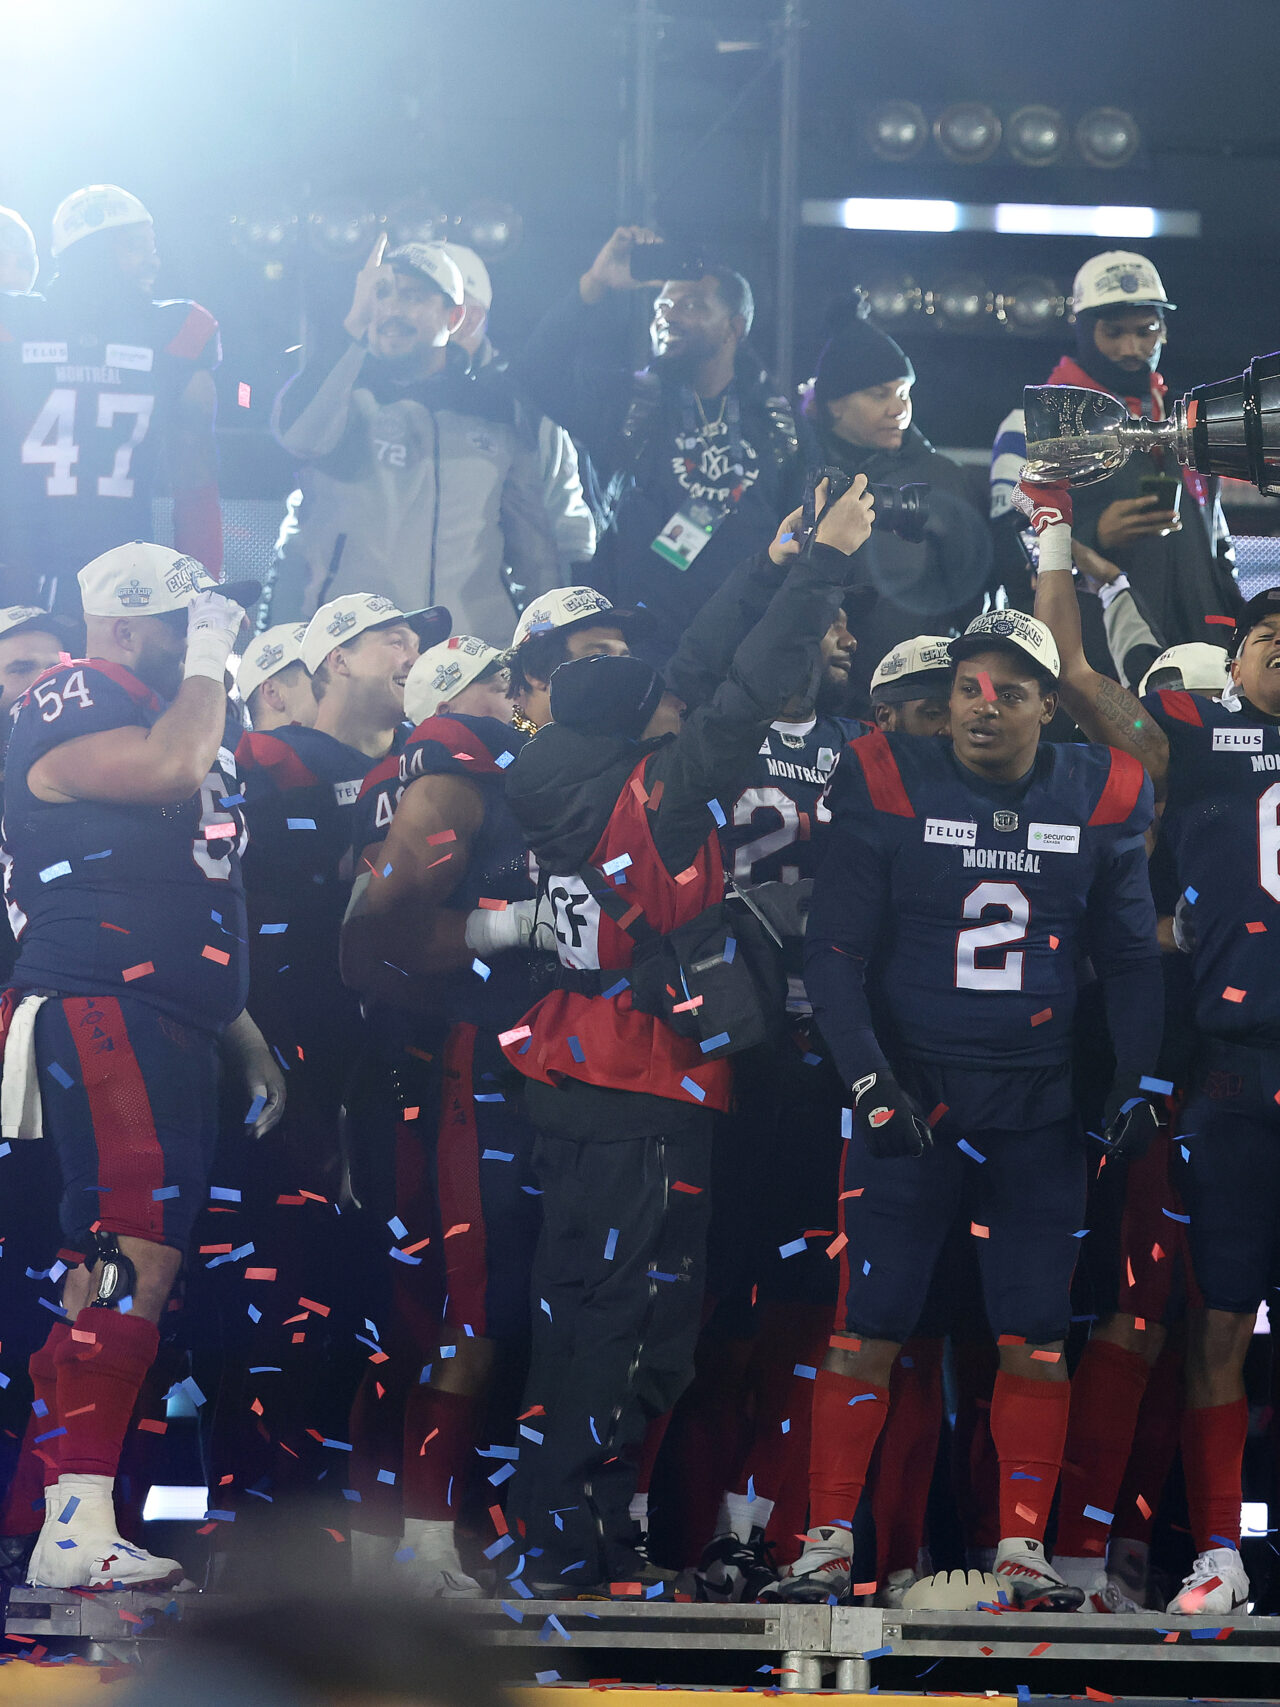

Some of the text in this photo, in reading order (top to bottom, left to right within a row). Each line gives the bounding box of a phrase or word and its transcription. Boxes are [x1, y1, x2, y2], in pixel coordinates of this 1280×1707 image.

[22, 388, 154, 497] 47
[373, 439, 407, 467] 72
[33, 670, 94, 723] 54
[1214, 735, 1262, 745] TELUS
[927, 825, 975, 839] TELUS
[1043, 833, 1076, 842] securian
[963, 849, 1041, 874] MONTRÉAL
[954, 880, 1031, 991] 2
